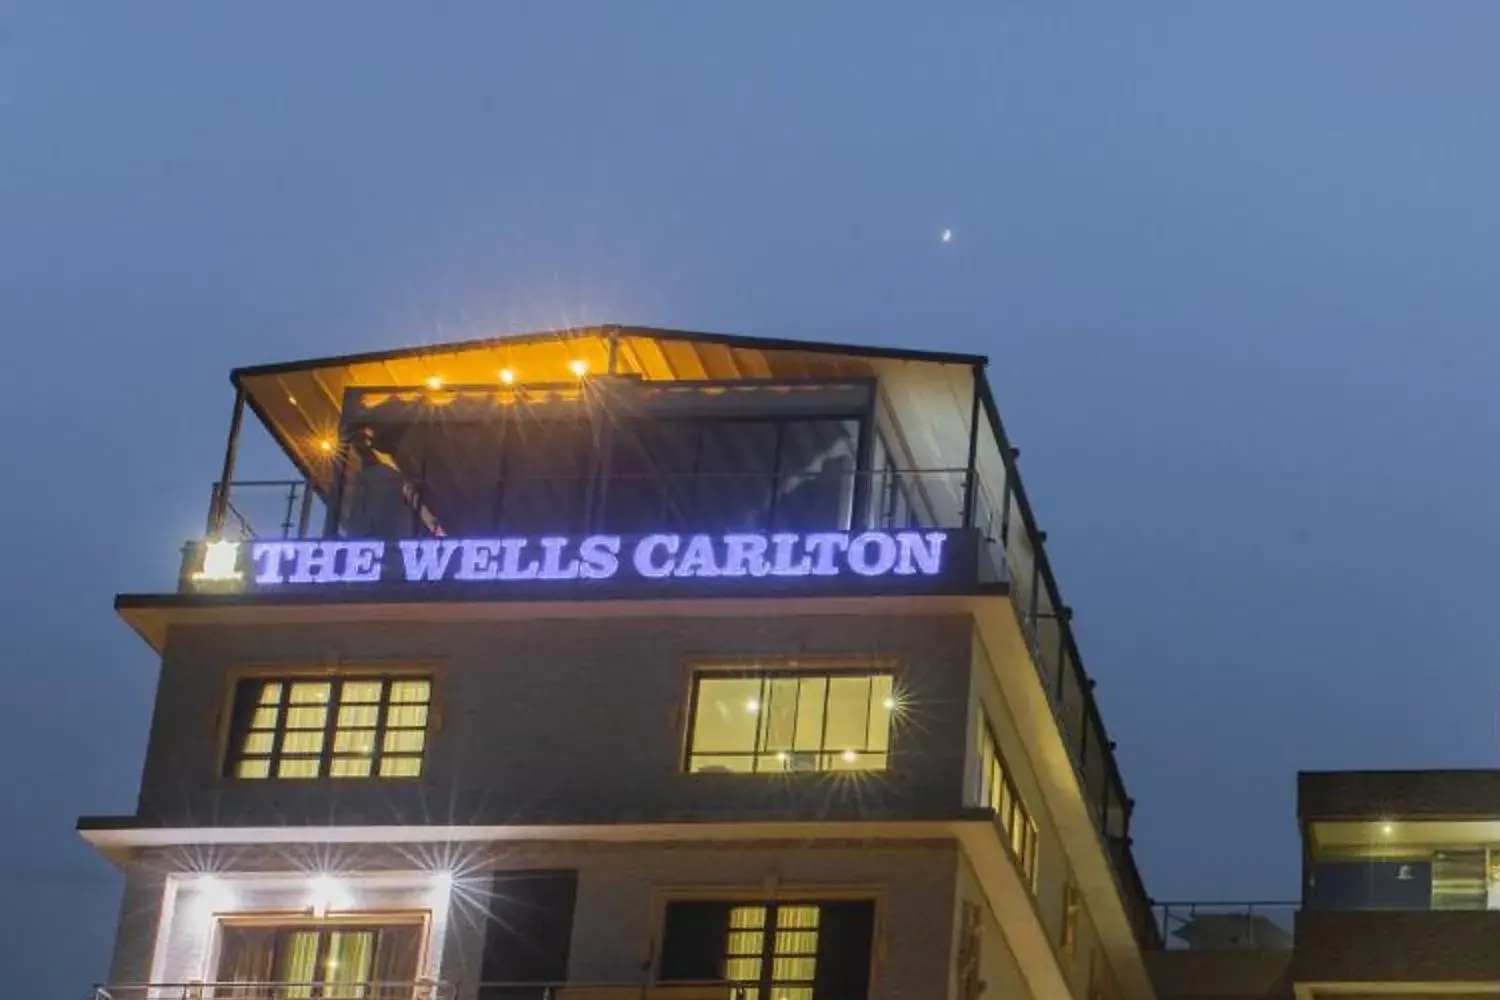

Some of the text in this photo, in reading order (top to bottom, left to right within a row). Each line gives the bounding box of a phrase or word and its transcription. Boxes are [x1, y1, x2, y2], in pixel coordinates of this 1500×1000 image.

[252, 531, 947, 585] THE WELLS CARLTON
